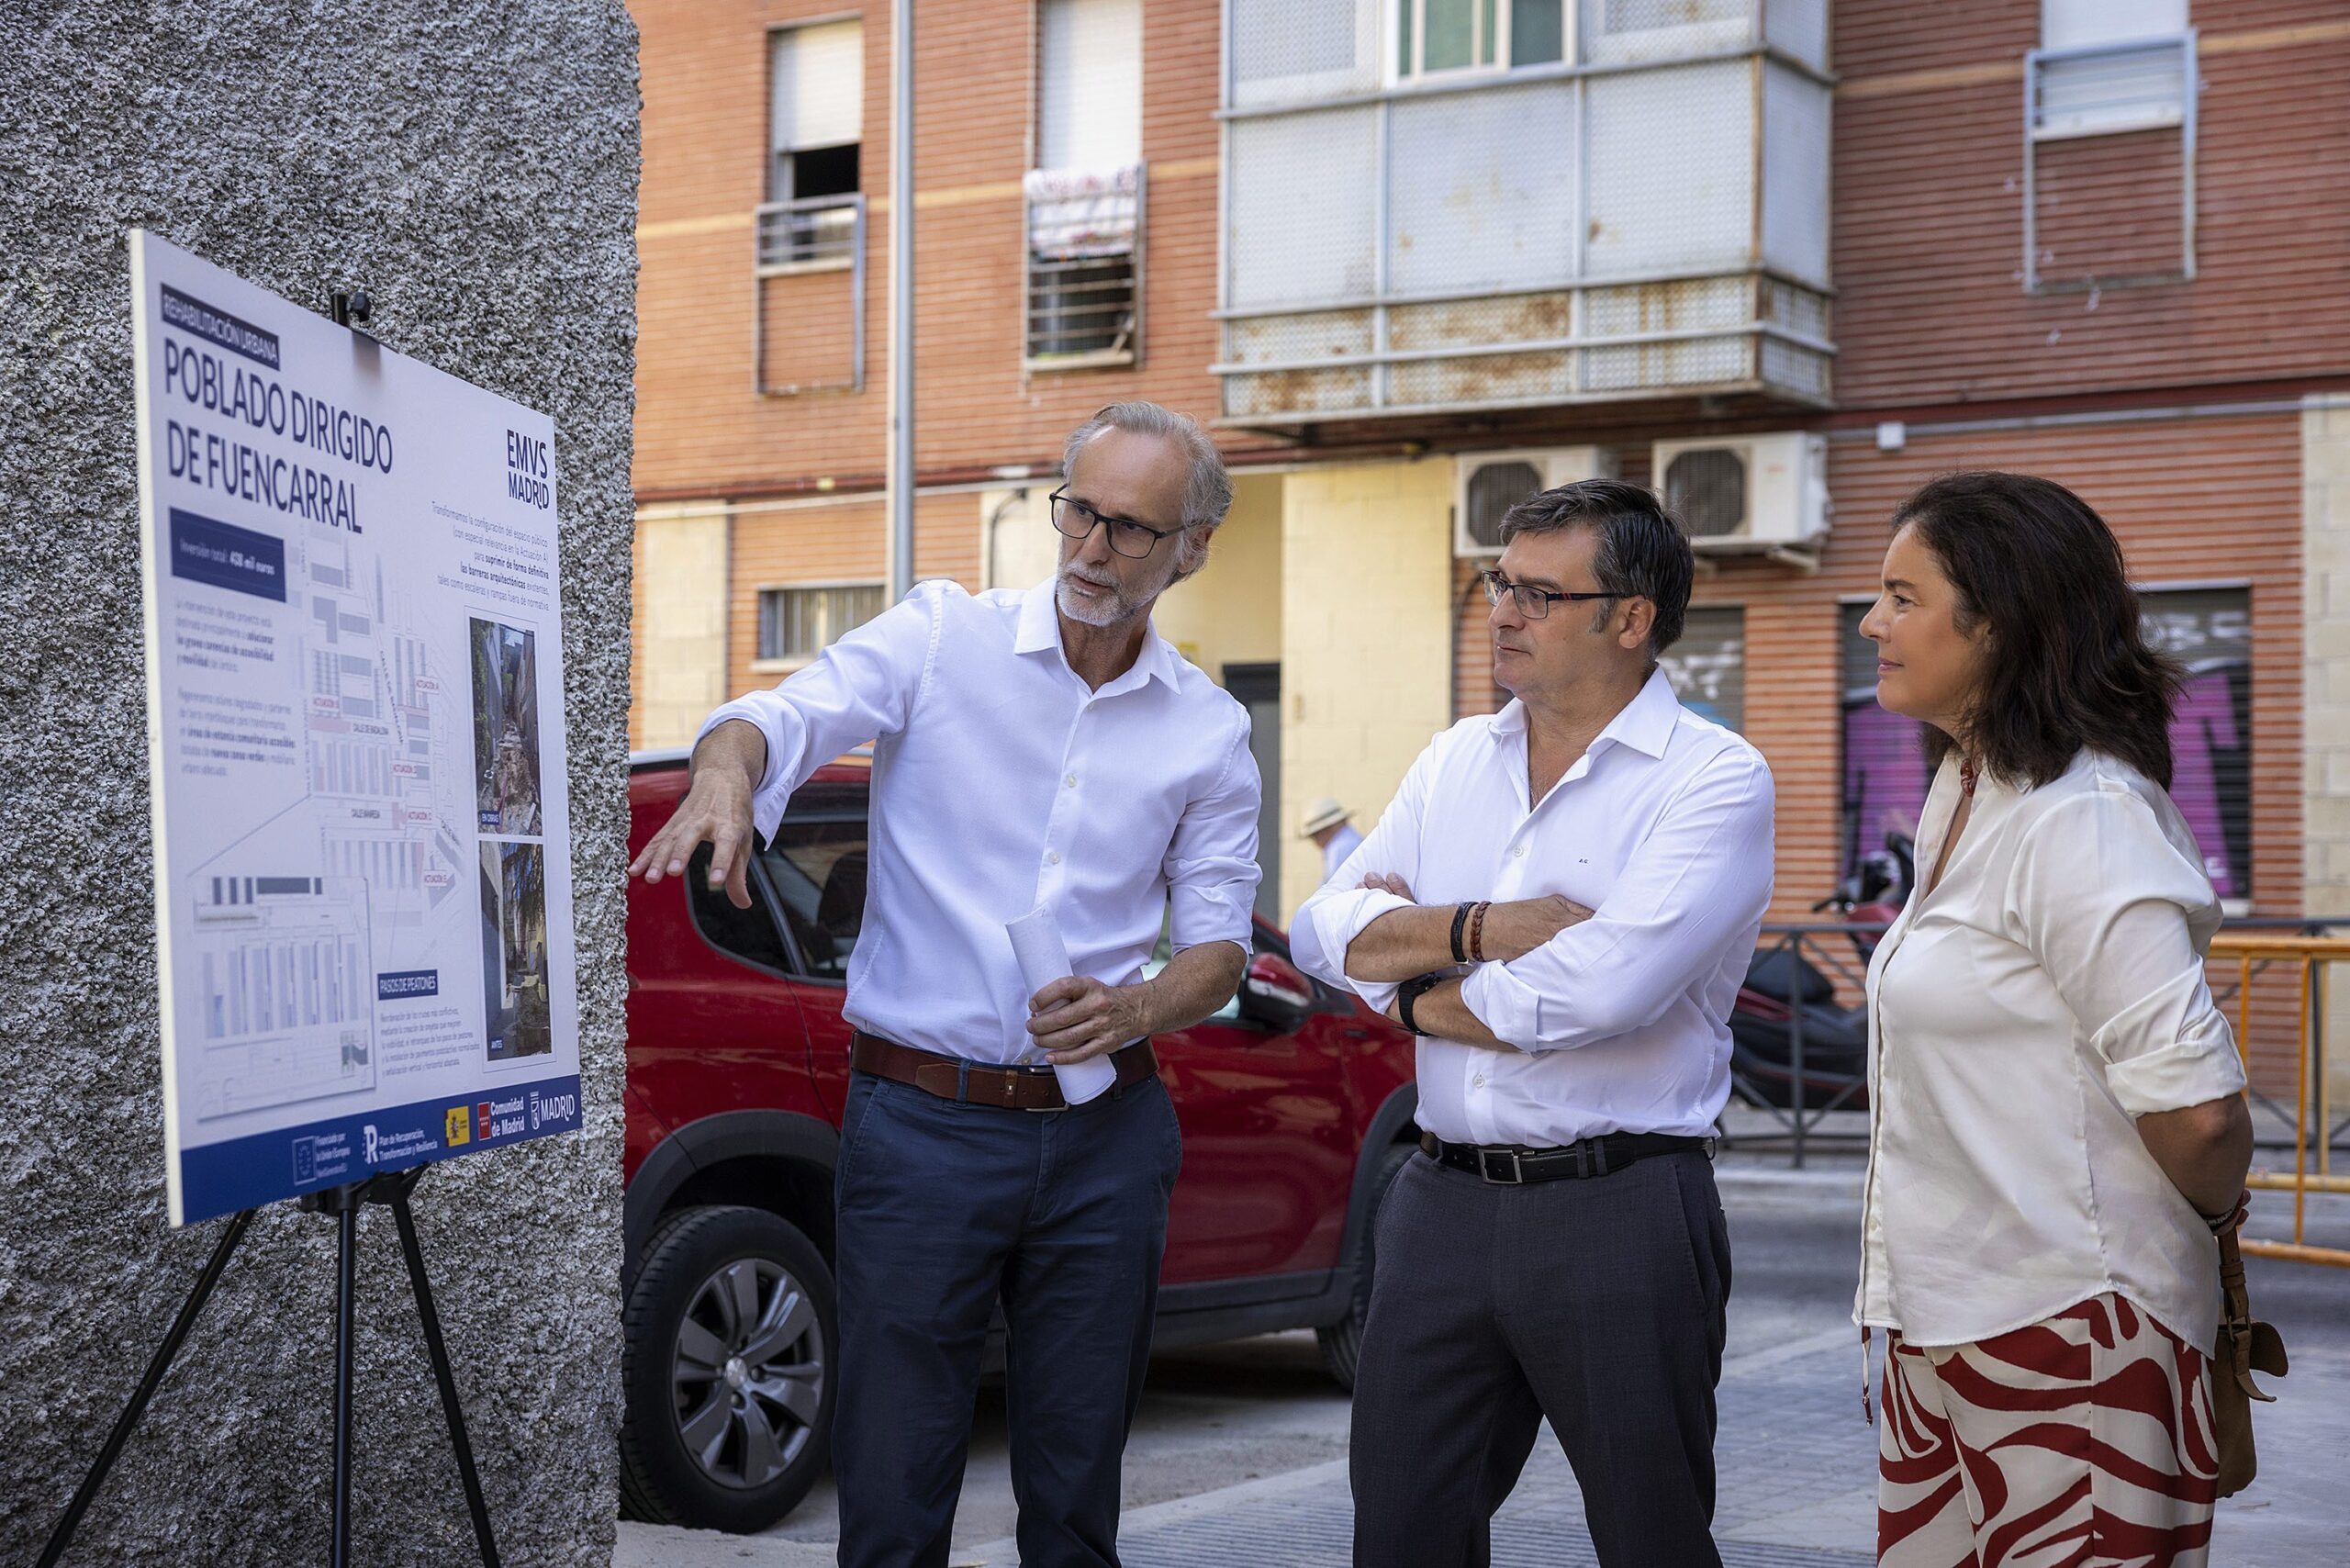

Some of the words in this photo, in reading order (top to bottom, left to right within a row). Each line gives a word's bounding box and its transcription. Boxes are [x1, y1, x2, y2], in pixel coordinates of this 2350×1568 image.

[163, 293, 239, 347] REHABILITACIÓN
[241, 328, 277, 363] URBANA
[164, 337, 286, 435] POBLADO
[292, 390, 393, 475] DIRIGIDO
[507, 429, 548, 478] EMVS
[167, 419, 202, 486] DE
[206, 432, 363, 534] FUENCARRAL
[508, 471, 549, 510] MADRID
[468, 563, 488, 579] barreras
[486, 554, 505, 567] suprimir
[506, 557, 512, 569] de
[513, 558, 527, 574] forma
[379, 978, 398, 994] PASOS
[399, 977, 407, 992] DE
[407, 975, 436, 992] PEATONES
[490, 1096, 524, 1116] Comunidad
[541, 1094, 575, 1122] MADRID
[491, 1121, 500, 1137] de
[501, 1115, 525, 1137] Madrid
